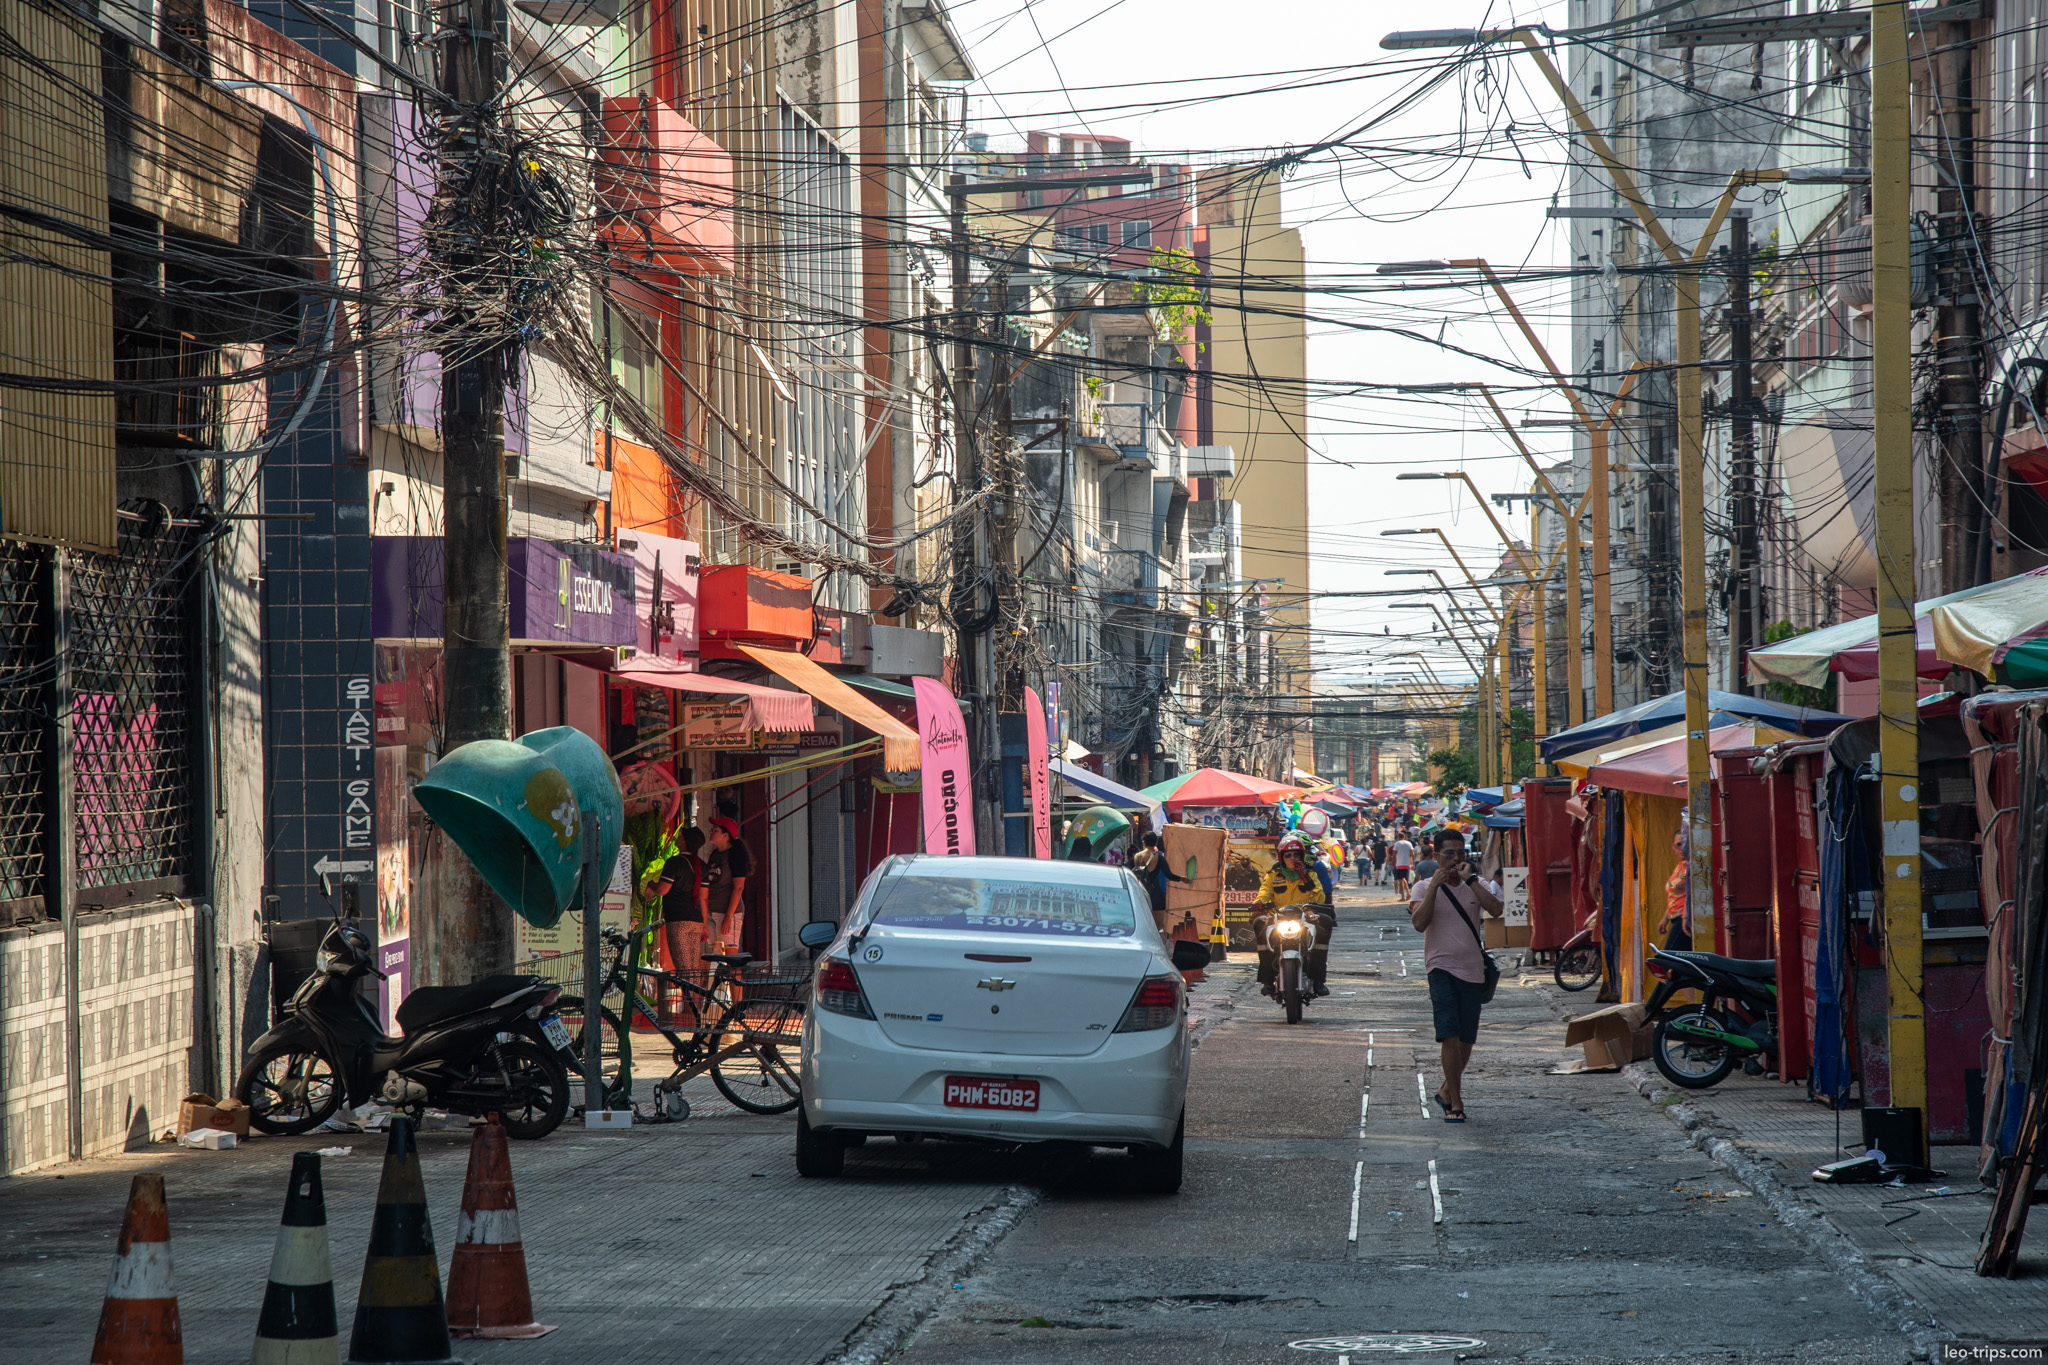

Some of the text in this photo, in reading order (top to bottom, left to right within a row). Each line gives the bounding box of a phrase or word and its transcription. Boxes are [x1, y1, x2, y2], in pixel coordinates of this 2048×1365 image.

[574, 571, 613, 615] ESSÊNCIAS
[691, 706, 743, 719] INDIA
[690, 733, 747, 746] HOUSE
[800, 736, 838, 746] REMA
[346, 780, 371, 847] GAME
[1226, 814, 1268, 829] Games
[987, 916, 1126, 937] 3071-5752
[867, 949, 879, 959] 15
[1675, 952, 1710, 962] HONDA
